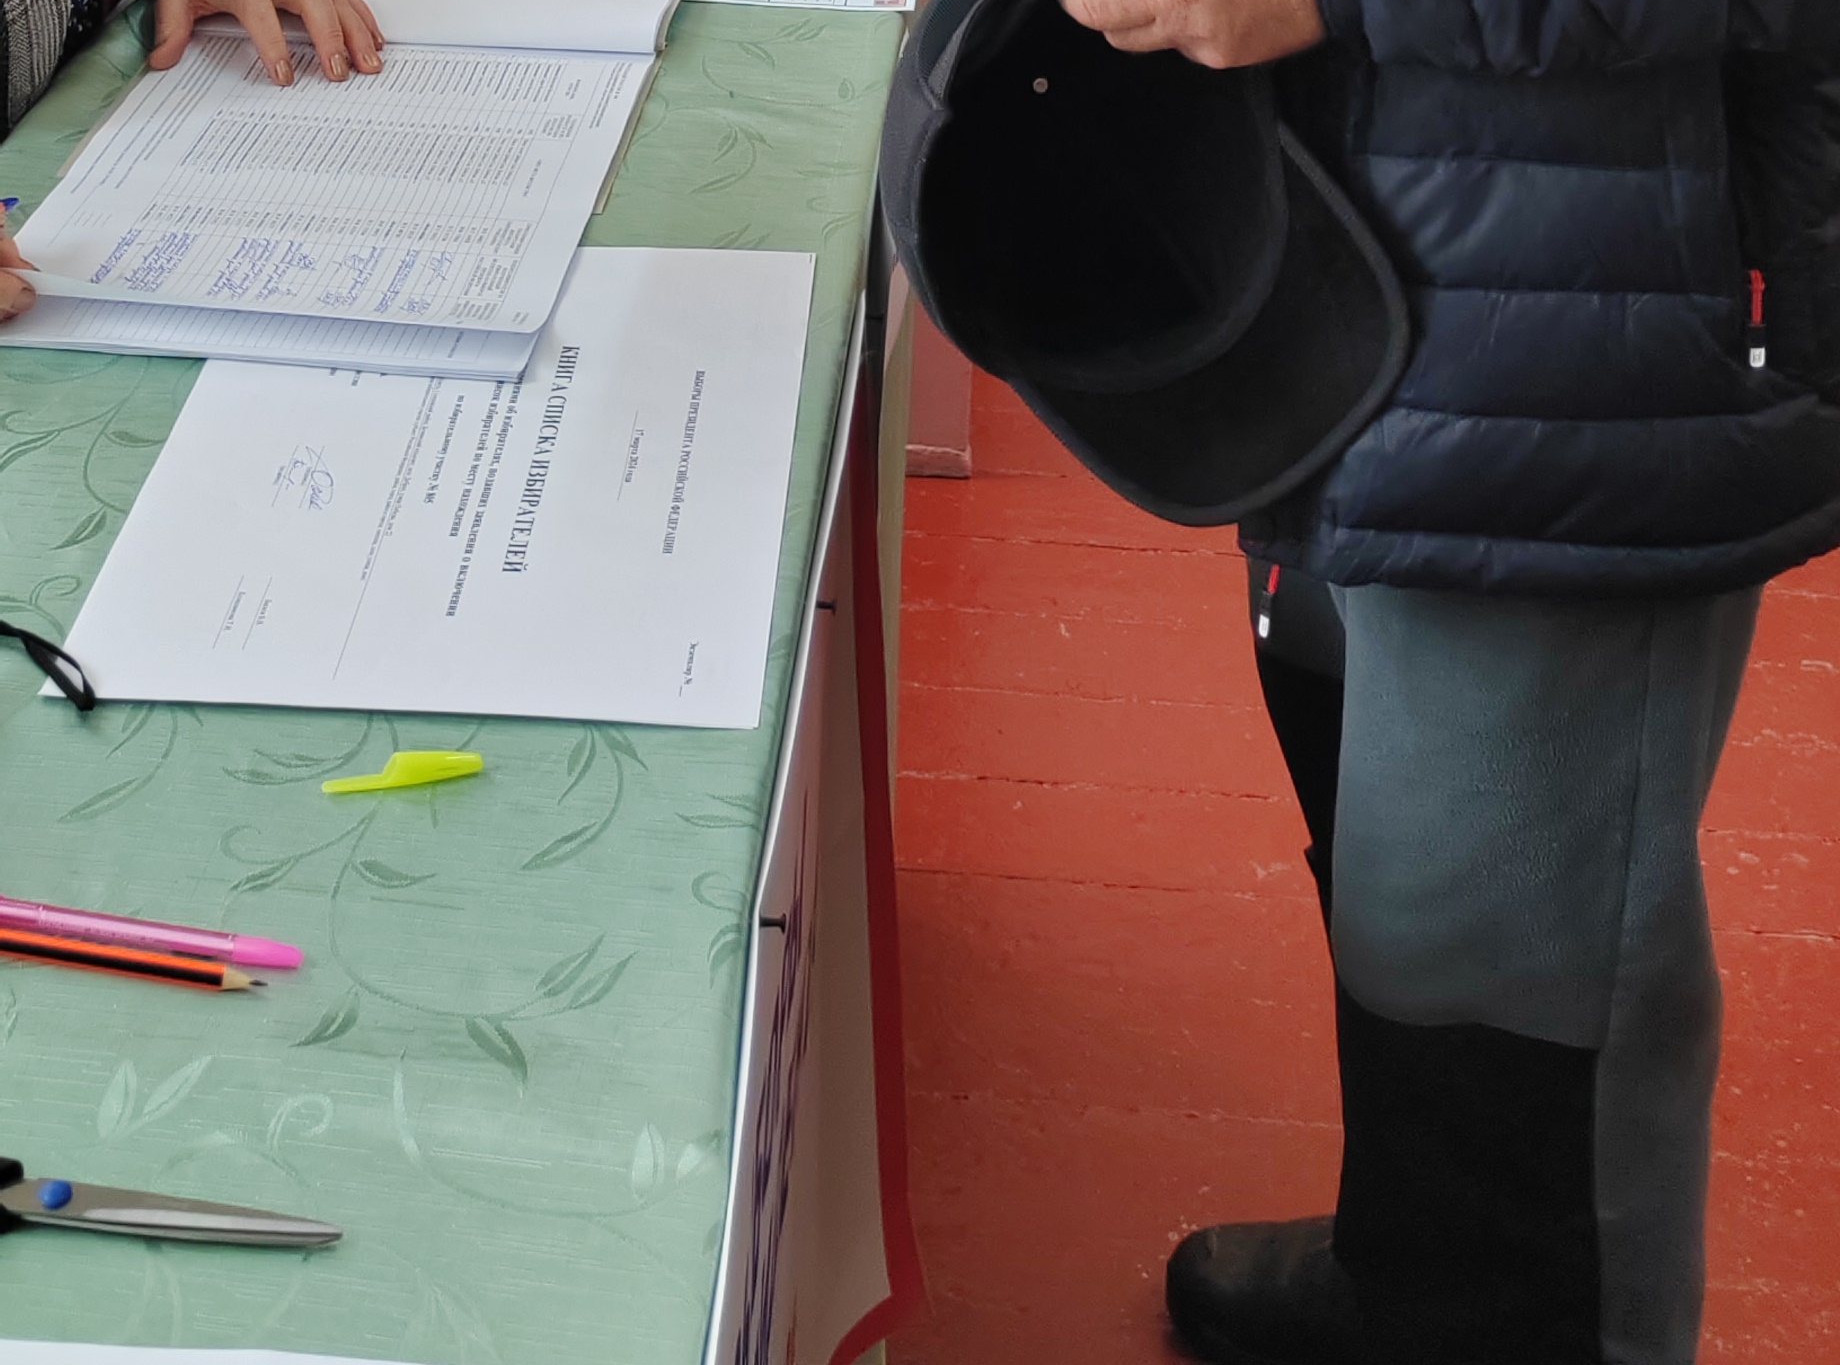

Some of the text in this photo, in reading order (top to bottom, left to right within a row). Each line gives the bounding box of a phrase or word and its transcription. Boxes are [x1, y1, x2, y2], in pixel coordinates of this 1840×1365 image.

[476, 403, 499, 453] избирателей
[630, 437, 641, 454] марта
[636, 429, 645, 437] 17
[502, 345, 580, 573] КНИГА СПИСКА ИЗБИРАТЕЛЕЙ
[662, 370, 705, 554] ВЫБОРЫ ПРЕЗИДЕНТА РОССИЙСКОЙ ФЕДЕРАЦИИ
[477, 467, 497, 508] подавших
